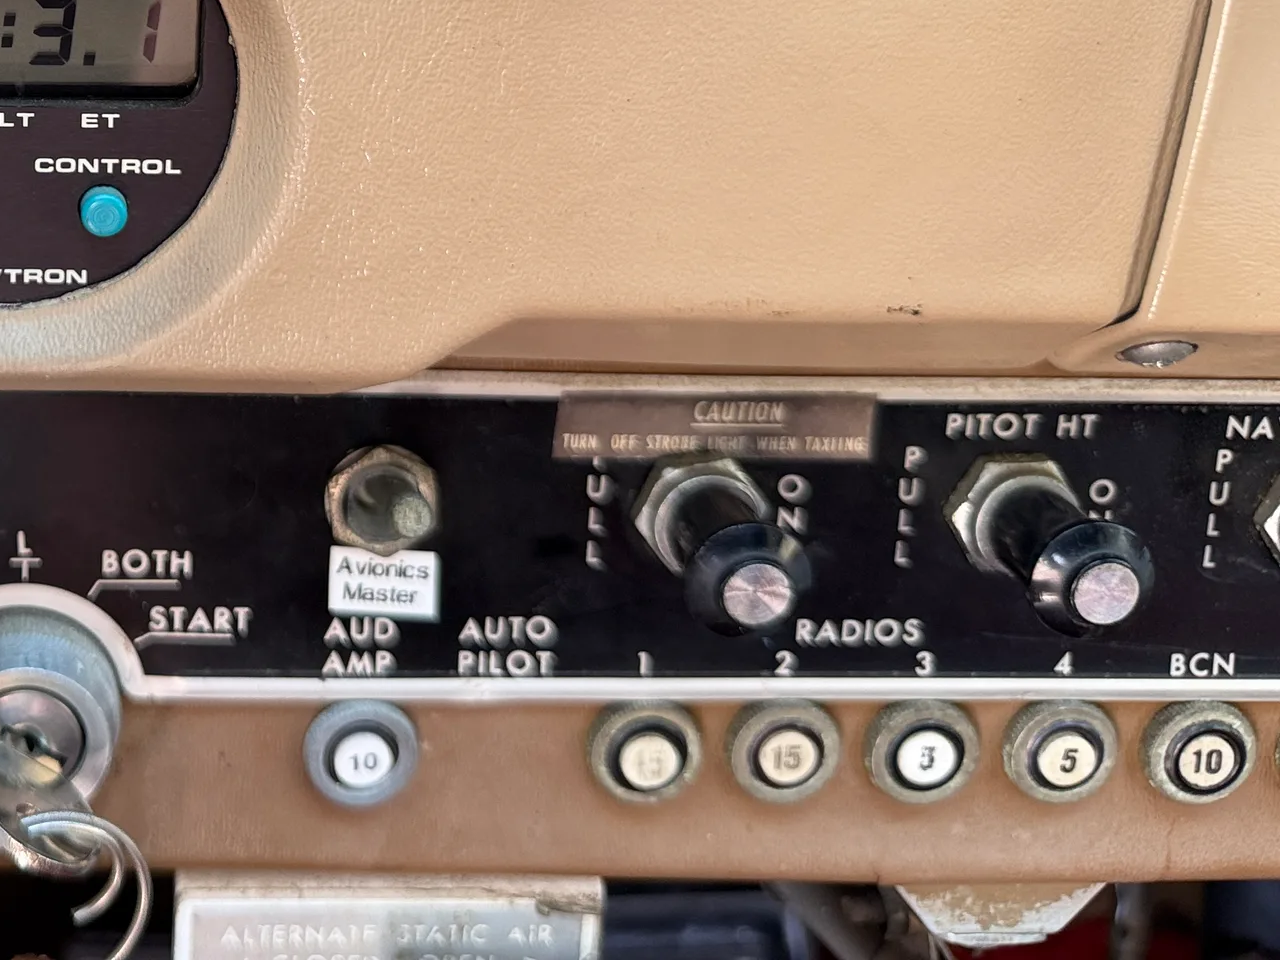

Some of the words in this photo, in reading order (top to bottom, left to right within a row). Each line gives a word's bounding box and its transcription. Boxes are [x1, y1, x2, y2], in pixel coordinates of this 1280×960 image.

[80, 114, 121, 130] ET
[34, 157, 182, 176] CONTROL
[693, 401, 785, 423] CAUTION
[945, 412, 1042, 440] PITOT
[1055, 413, 1100, 439] HT
[1225, 414, 1280, 440] NA
[562, 433, 598, 450] TURN
[610, 433, 637, 450] OFF
[646, 433, 698, 450] STROBE
[707, 434, 747, 451] LIGHT
[756, 435, 797, 451] WHEN
[805, 435, 867, 451] TAXIING
[777, 474, 811, 535] ON
[895, 446, 926, 568] PULL
[1202, 448, 1233, 569] PULL
[16, 530, 33, 556] L
[102, 549, 193, 579] BOTH
[336, 555, 430, 580] Avionics
[342, 580, 418, 604] Master
[149, 605, 254, 637] START
[323, 616, 400, 647] AUD
[458, 615, 558, 647] AUTO
[795, 618, 923, 647] RADIOS
[321, 650, 396, 677] AMP
[458, 650, 557, 677] PILOT
[636, 651, 653, 677] 1
[774, 651, 796, 677] 2
[915, 652, 935, 676] 3
[1053, 651, 1074, 675] 4
[1169, 652, 1236, 677] BCN
[349, 752, 378, 771] 10
[771, 744, 802, 770] 15
[1059, 747, 1079, 773] 5
[1191, 747, 1223, 776] 10
[507, 923, 556, 947] AIR
